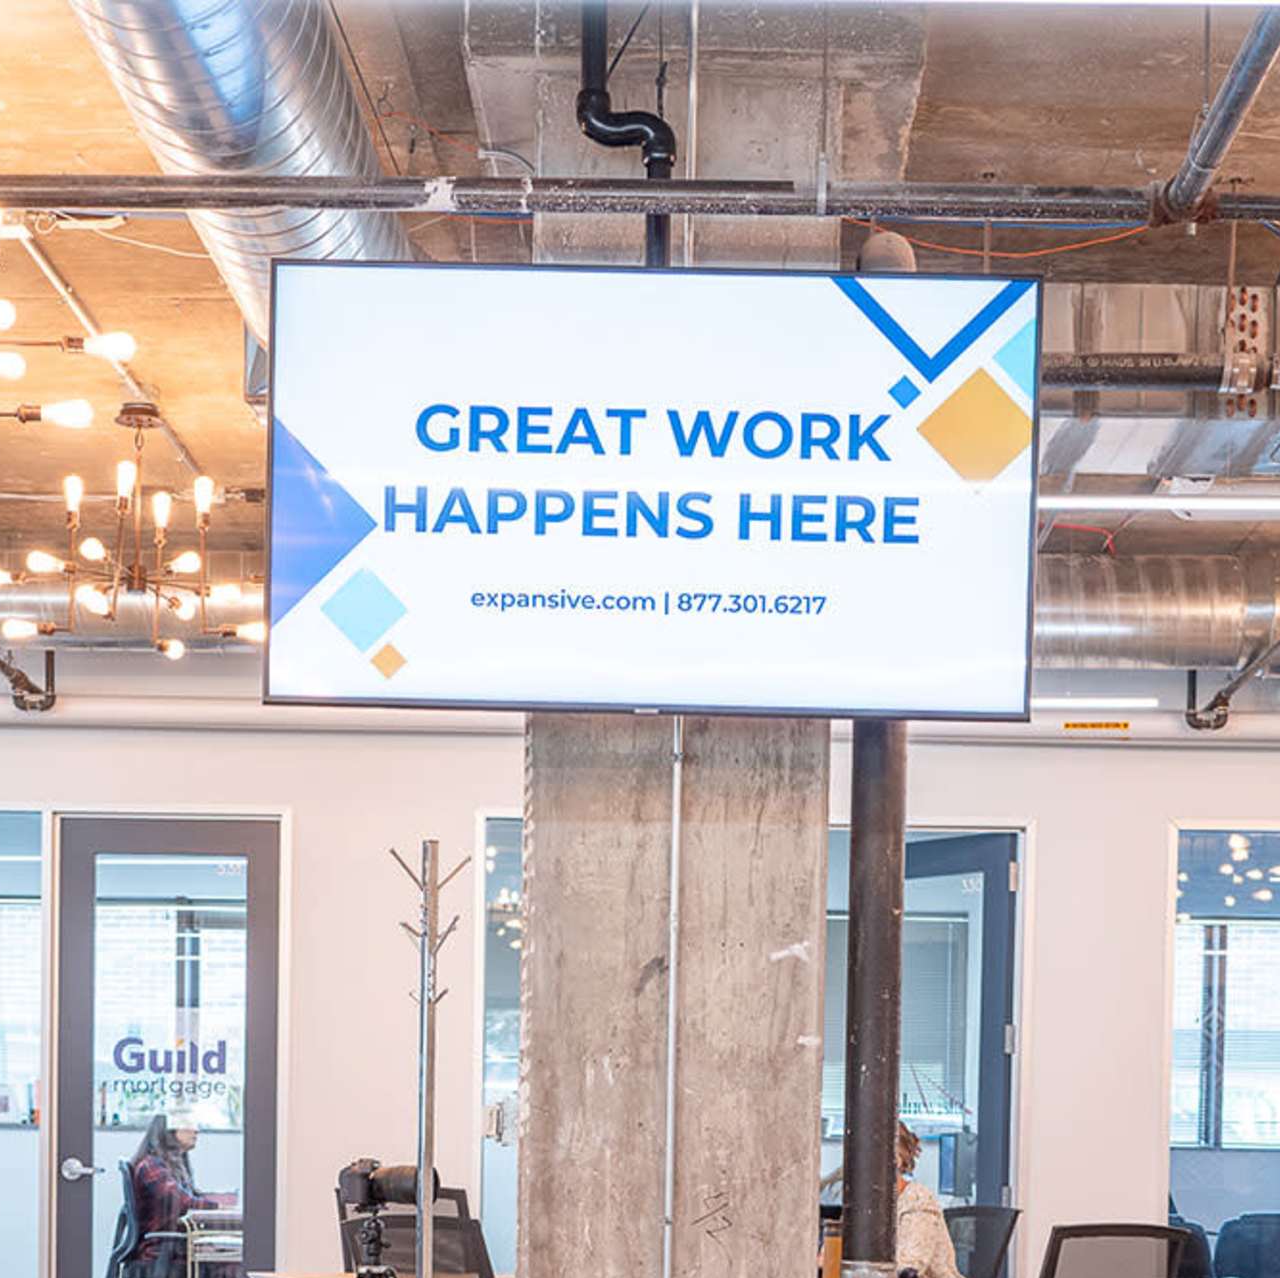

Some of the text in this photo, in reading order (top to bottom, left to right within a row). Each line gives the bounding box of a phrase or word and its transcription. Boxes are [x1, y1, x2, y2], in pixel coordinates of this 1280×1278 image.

[415, 403, 893, 462] GREAT WORK
[383, 485, 921, 544] HAPPENS HERE
[470, 588, 656, 612] expansive.com
[677, 592, 828, 615] 877.301.6217
[113, 1037, 226, 1074] Guild
[113, 1076, 226, 1099] mortgage
